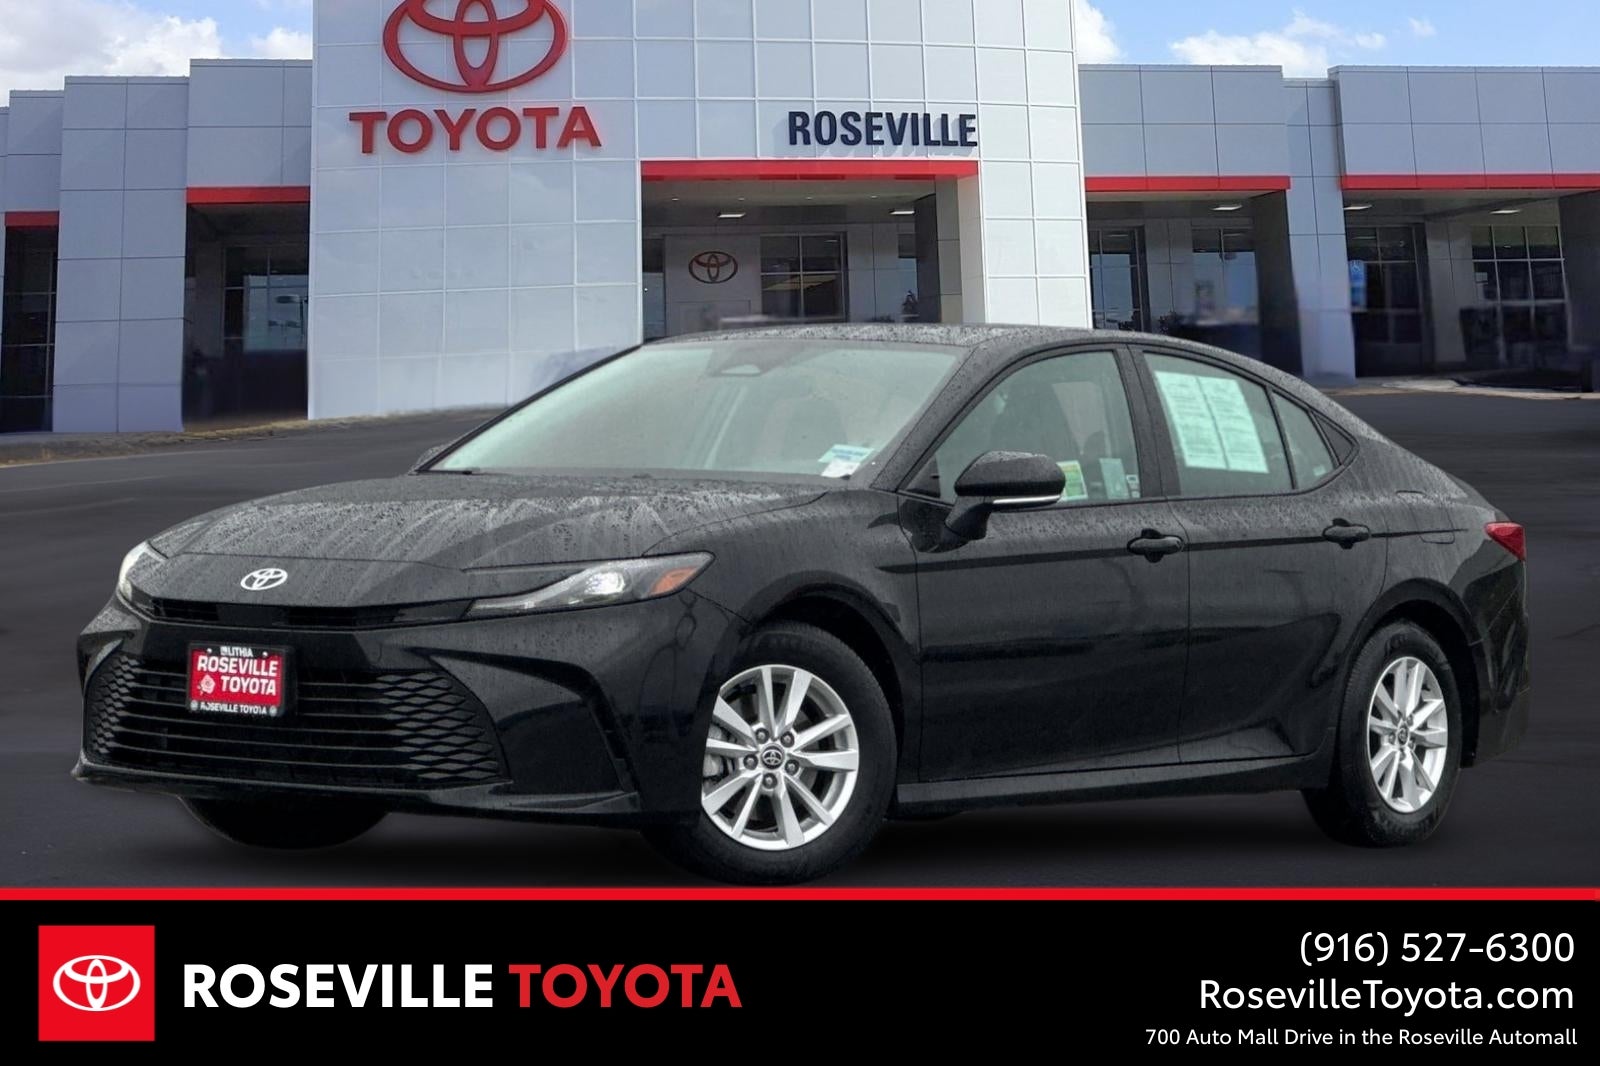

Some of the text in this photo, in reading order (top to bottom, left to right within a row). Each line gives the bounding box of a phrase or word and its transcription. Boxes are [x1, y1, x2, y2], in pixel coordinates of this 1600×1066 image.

[349, 106, 602, 154] TOYOTA
[788, 110, 978, 147] ROSEVILLE
[228, 646, 254, 657] LITHIA
[197, 655, 279, 677] ROSEVILLE
[220, 675, 277, 696] TOYOTA
[240, 704, 267, 715] TOYOTA
